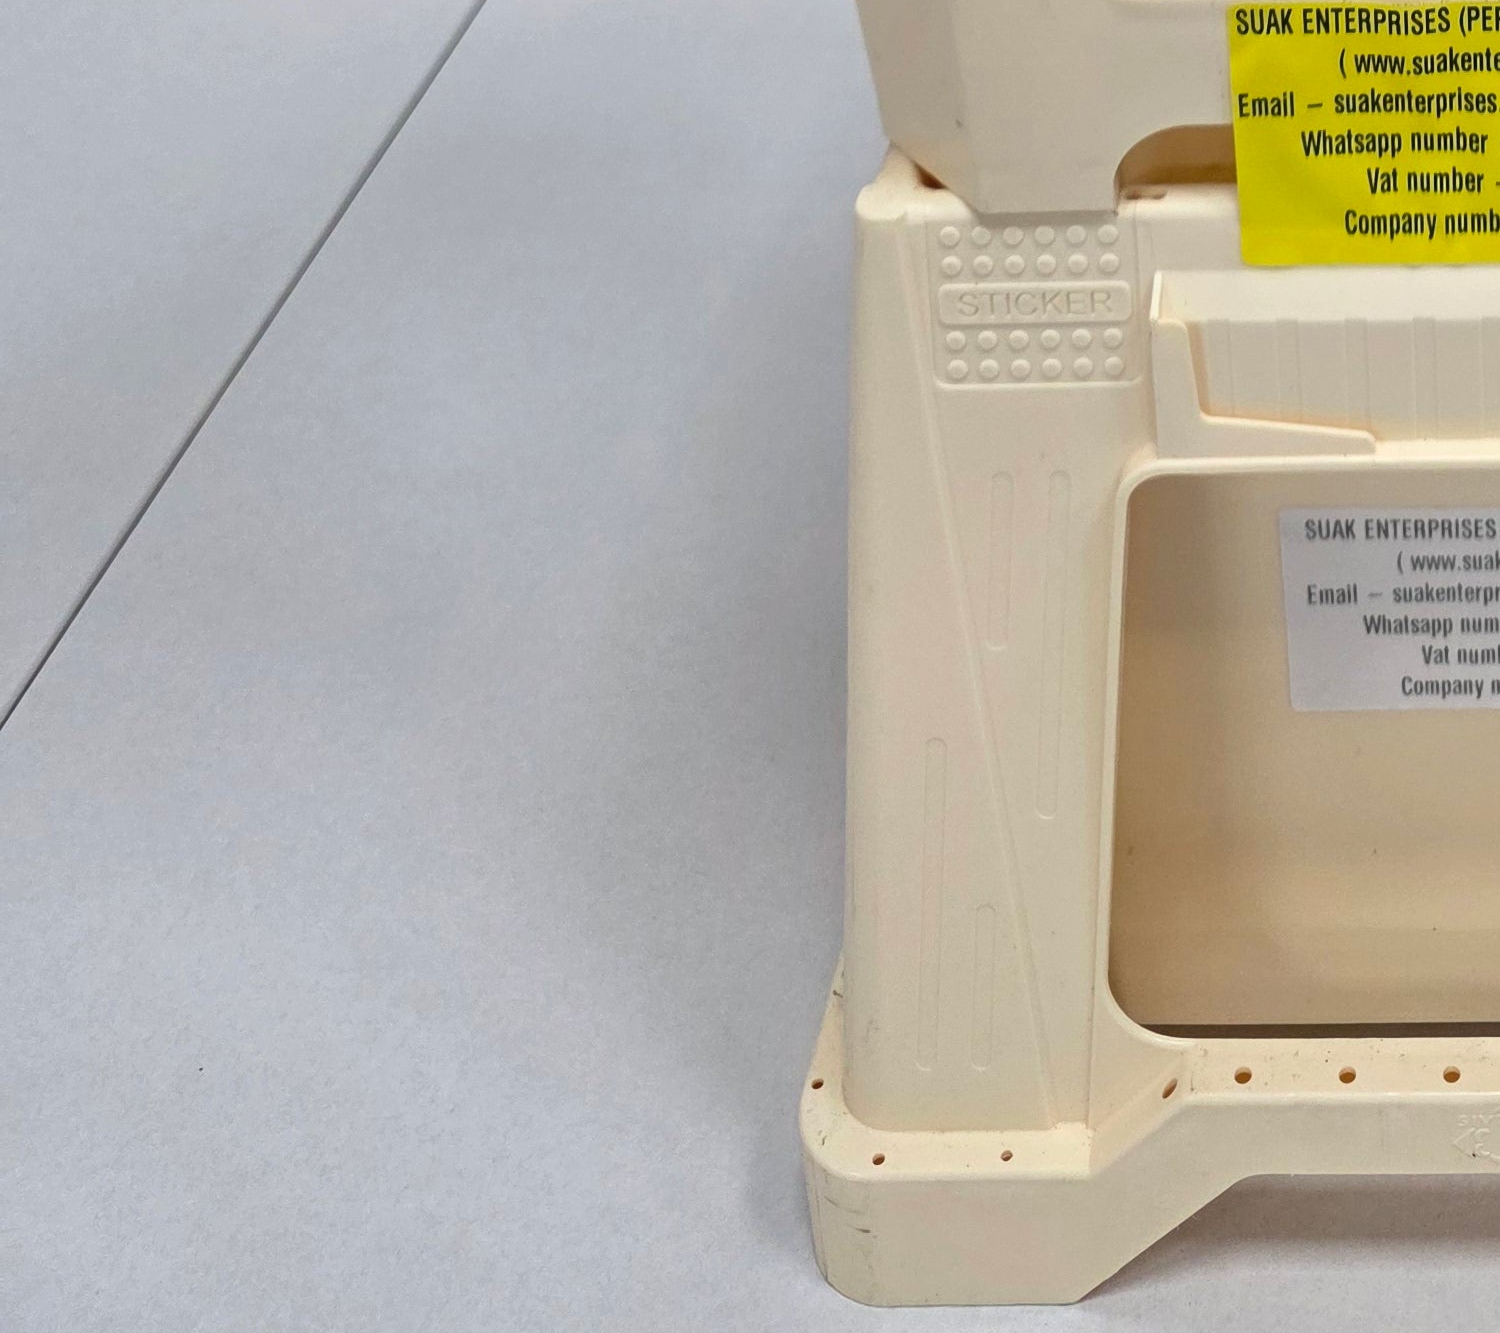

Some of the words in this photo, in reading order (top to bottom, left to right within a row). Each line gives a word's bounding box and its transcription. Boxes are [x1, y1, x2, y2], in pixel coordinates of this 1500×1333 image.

[1236, 9, 1293, 35] SUAK
[1303, 7, 1450, 35] ENTERPRISES
[1239, 92, 1294, 117] Email
[1301, 130, 1401, 158] Whatsapp
[1411, 127, 1488, 153] number
[1367, 168, 1398, 194] Vat
[1408, 167, 1484, 193] number
[1345, 210, 1436, 240] Company
[958, 290, 1112, 317] STICKER
[1305, 519, 1355, 540] SUAK
[1365, 519, 1496, 539] ENTERPRISES
[1308, 584, 1357, 605] Email
[1363, 615, 1452, 637] Whatsapp
[1422, 645, 1449, 665] Vat
[1402, 677, 1483, 699] Company
